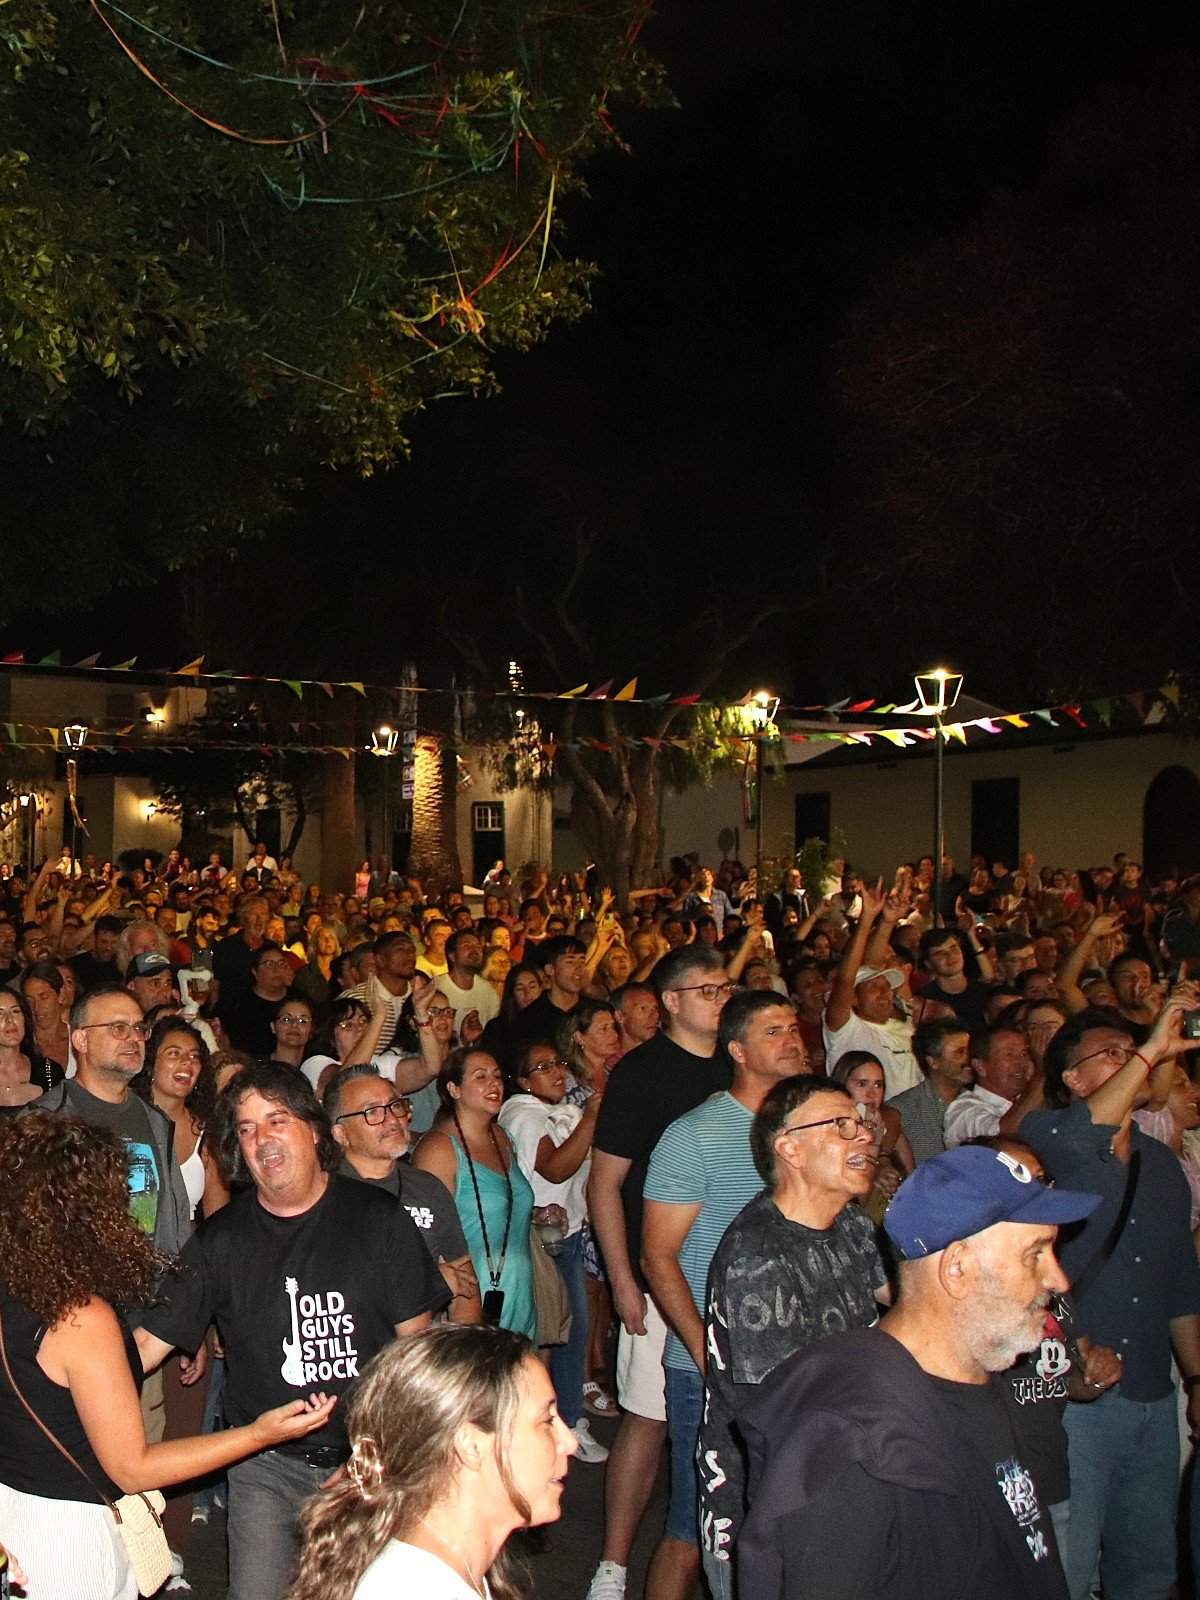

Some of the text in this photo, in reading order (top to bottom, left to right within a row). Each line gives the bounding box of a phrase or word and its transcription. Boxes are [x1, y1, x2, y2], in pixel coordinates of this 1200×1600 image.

[299, 1291, 345, 1318] OLD
[301, 1313, 355, 1339] GUYS
[302, 1335, 358, 1361] STILL
[304, 1356, 360, 1384] ROCK
[1012, 1377, 1044, 1406] THE
